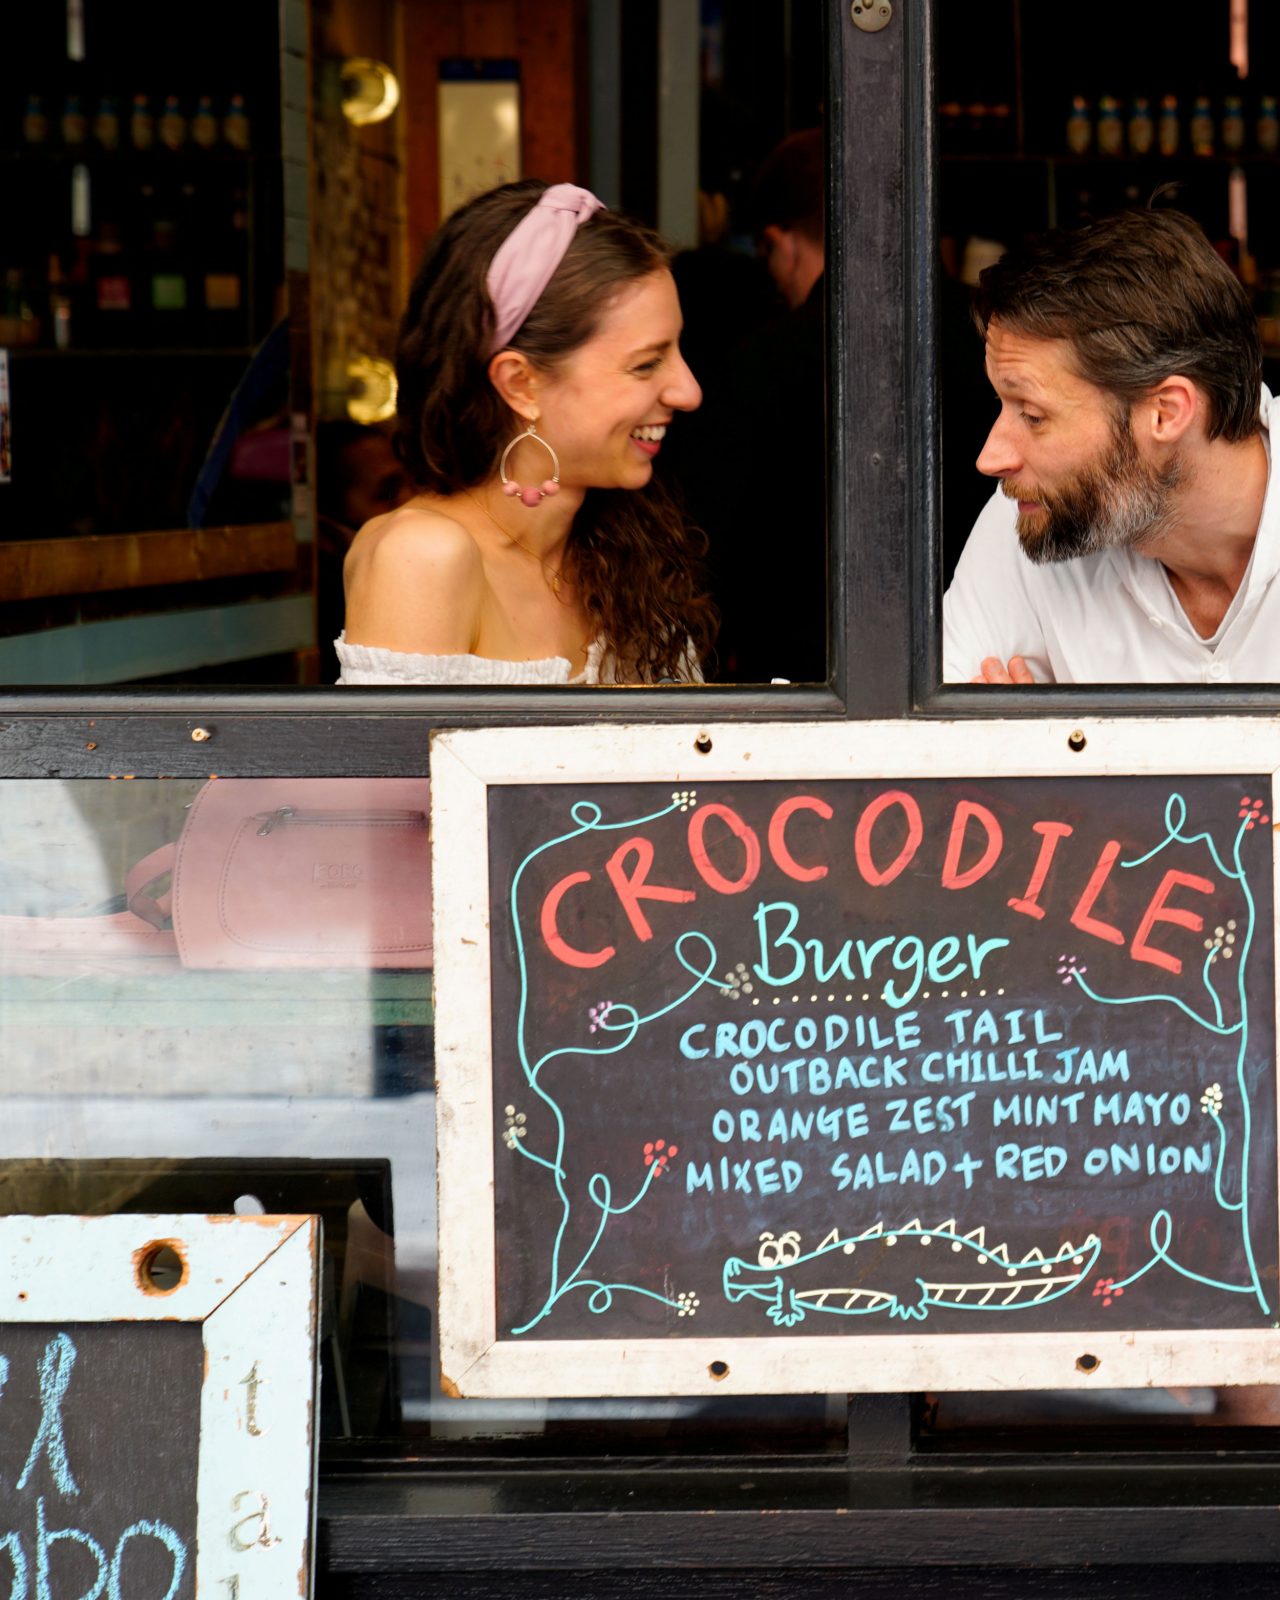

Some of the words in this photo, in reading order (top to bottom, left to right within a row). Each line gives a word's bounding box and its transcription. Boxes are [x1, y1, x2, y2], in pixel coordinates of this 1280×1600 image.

[541, 791, 1214, 972] CROCODILE
[754, 902, 1008, 1008] Burger
[680, 1014, 920, 1064] CROCODILE
[944, 1009, 1063, 1053] TAIL
[729, 1054, 908, 1095] OUTBACK
[918, 1048, 1044, 1084] CHILLI
[1050, 1046, 1130, 1085] JAM
[713, 1103, 869, 1144] ORANGE
[885, 1098, 974, 1134] ZEST
[993, 1092, 1084, 1127] MINT
[1094, 1092, 1190, 1126] MAYO
[687, 1156, 803, 1197] MIXED
[995, 1143, 1067, 1181] RED
[1084, 1142, 1212, 1175] ONION
